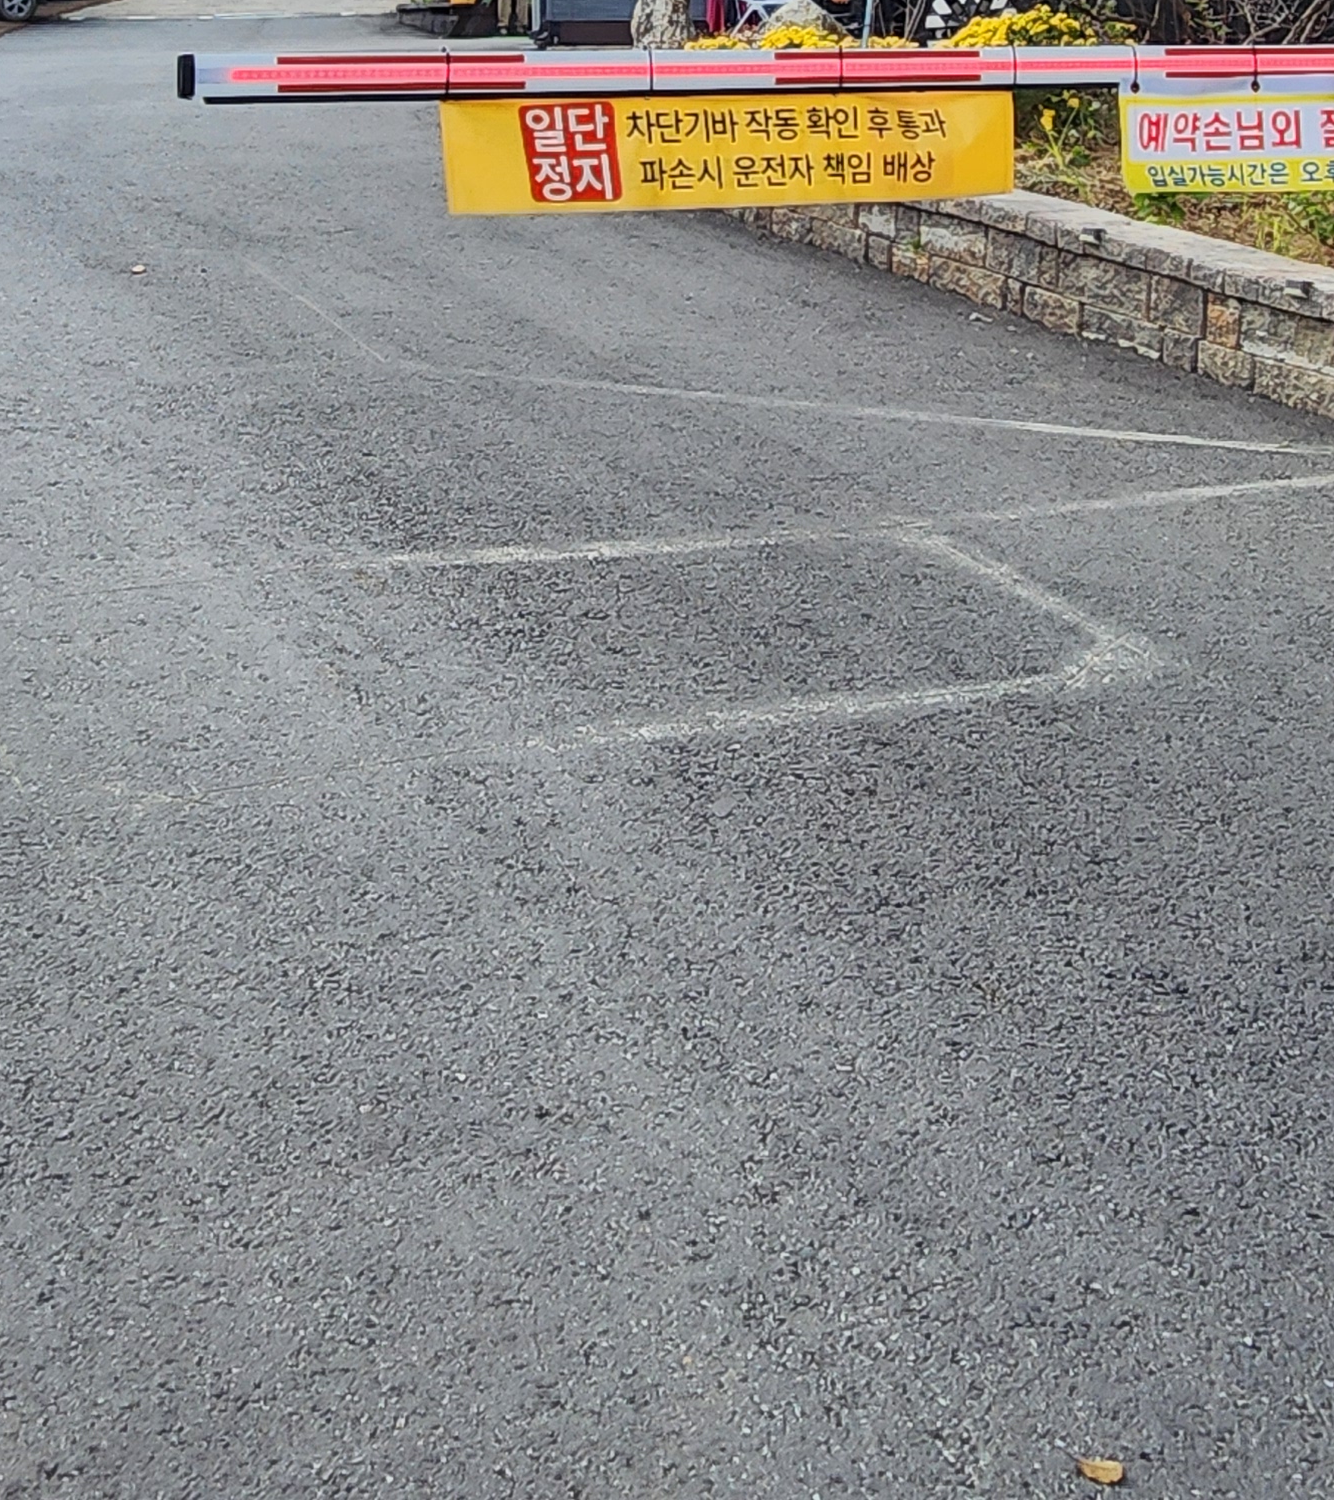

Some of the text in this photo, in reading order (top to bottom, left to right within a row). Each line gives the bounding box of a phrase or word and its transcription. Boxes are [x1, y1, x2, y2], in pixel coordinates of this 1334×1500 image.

[525, 104, 609, 152] 일단
[626, 109, 739, 144] 차단기바
[744, 108, 800, 141] 작동
[806, 106, 859, 140] 확인
[1139, 109, 1302, 152] 예약손님외
[532, 153, 613, 201] 정지
[639, 150, 936, 191] 파손시 운전자 책임 배상
[1147, 161, 1289, 187] 입실가능시간은
